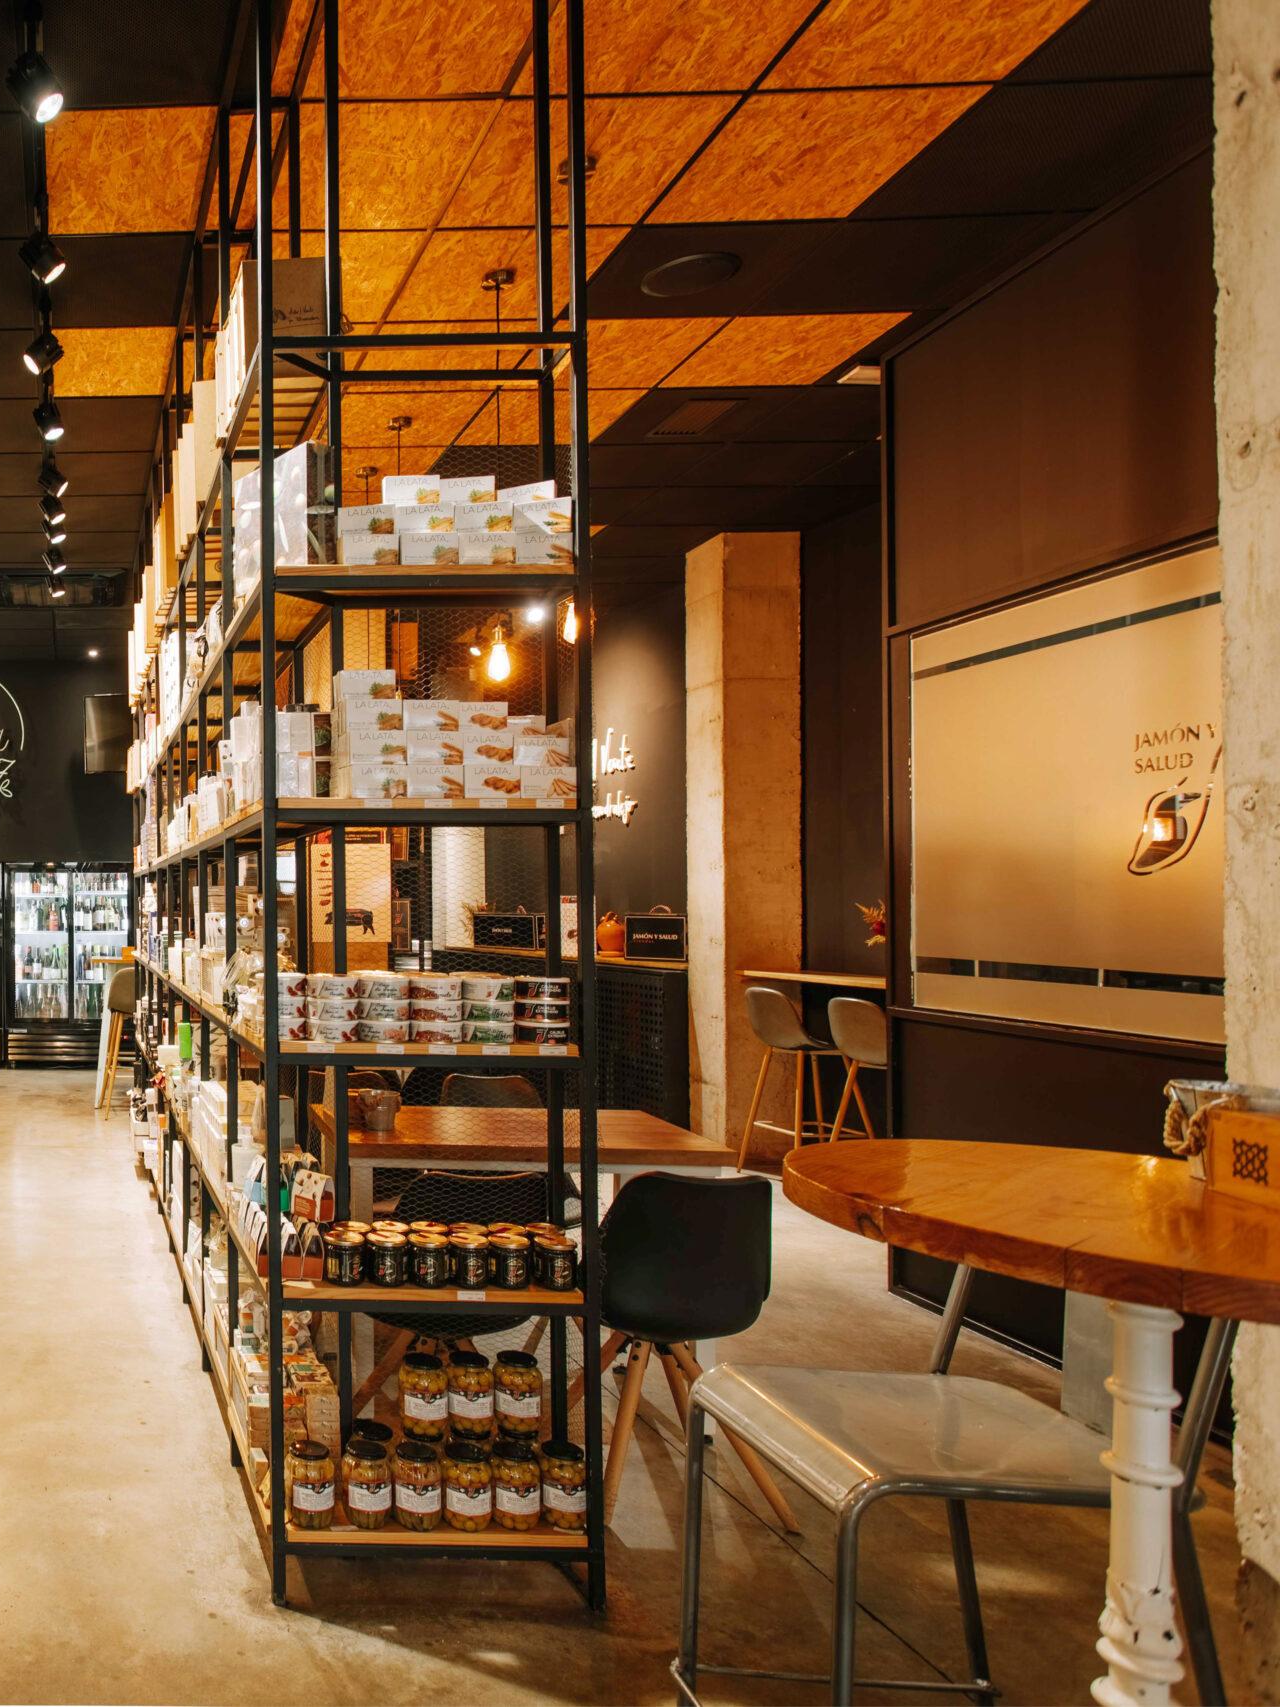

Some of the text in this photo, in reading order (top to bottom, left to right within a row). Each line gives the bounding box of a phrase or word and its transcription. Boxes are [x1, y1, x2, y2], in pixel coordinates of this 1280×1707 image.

[1134, 723, 1218, 752] JAMÓN Y
[1135, 752, 1194, 774] SALUD
